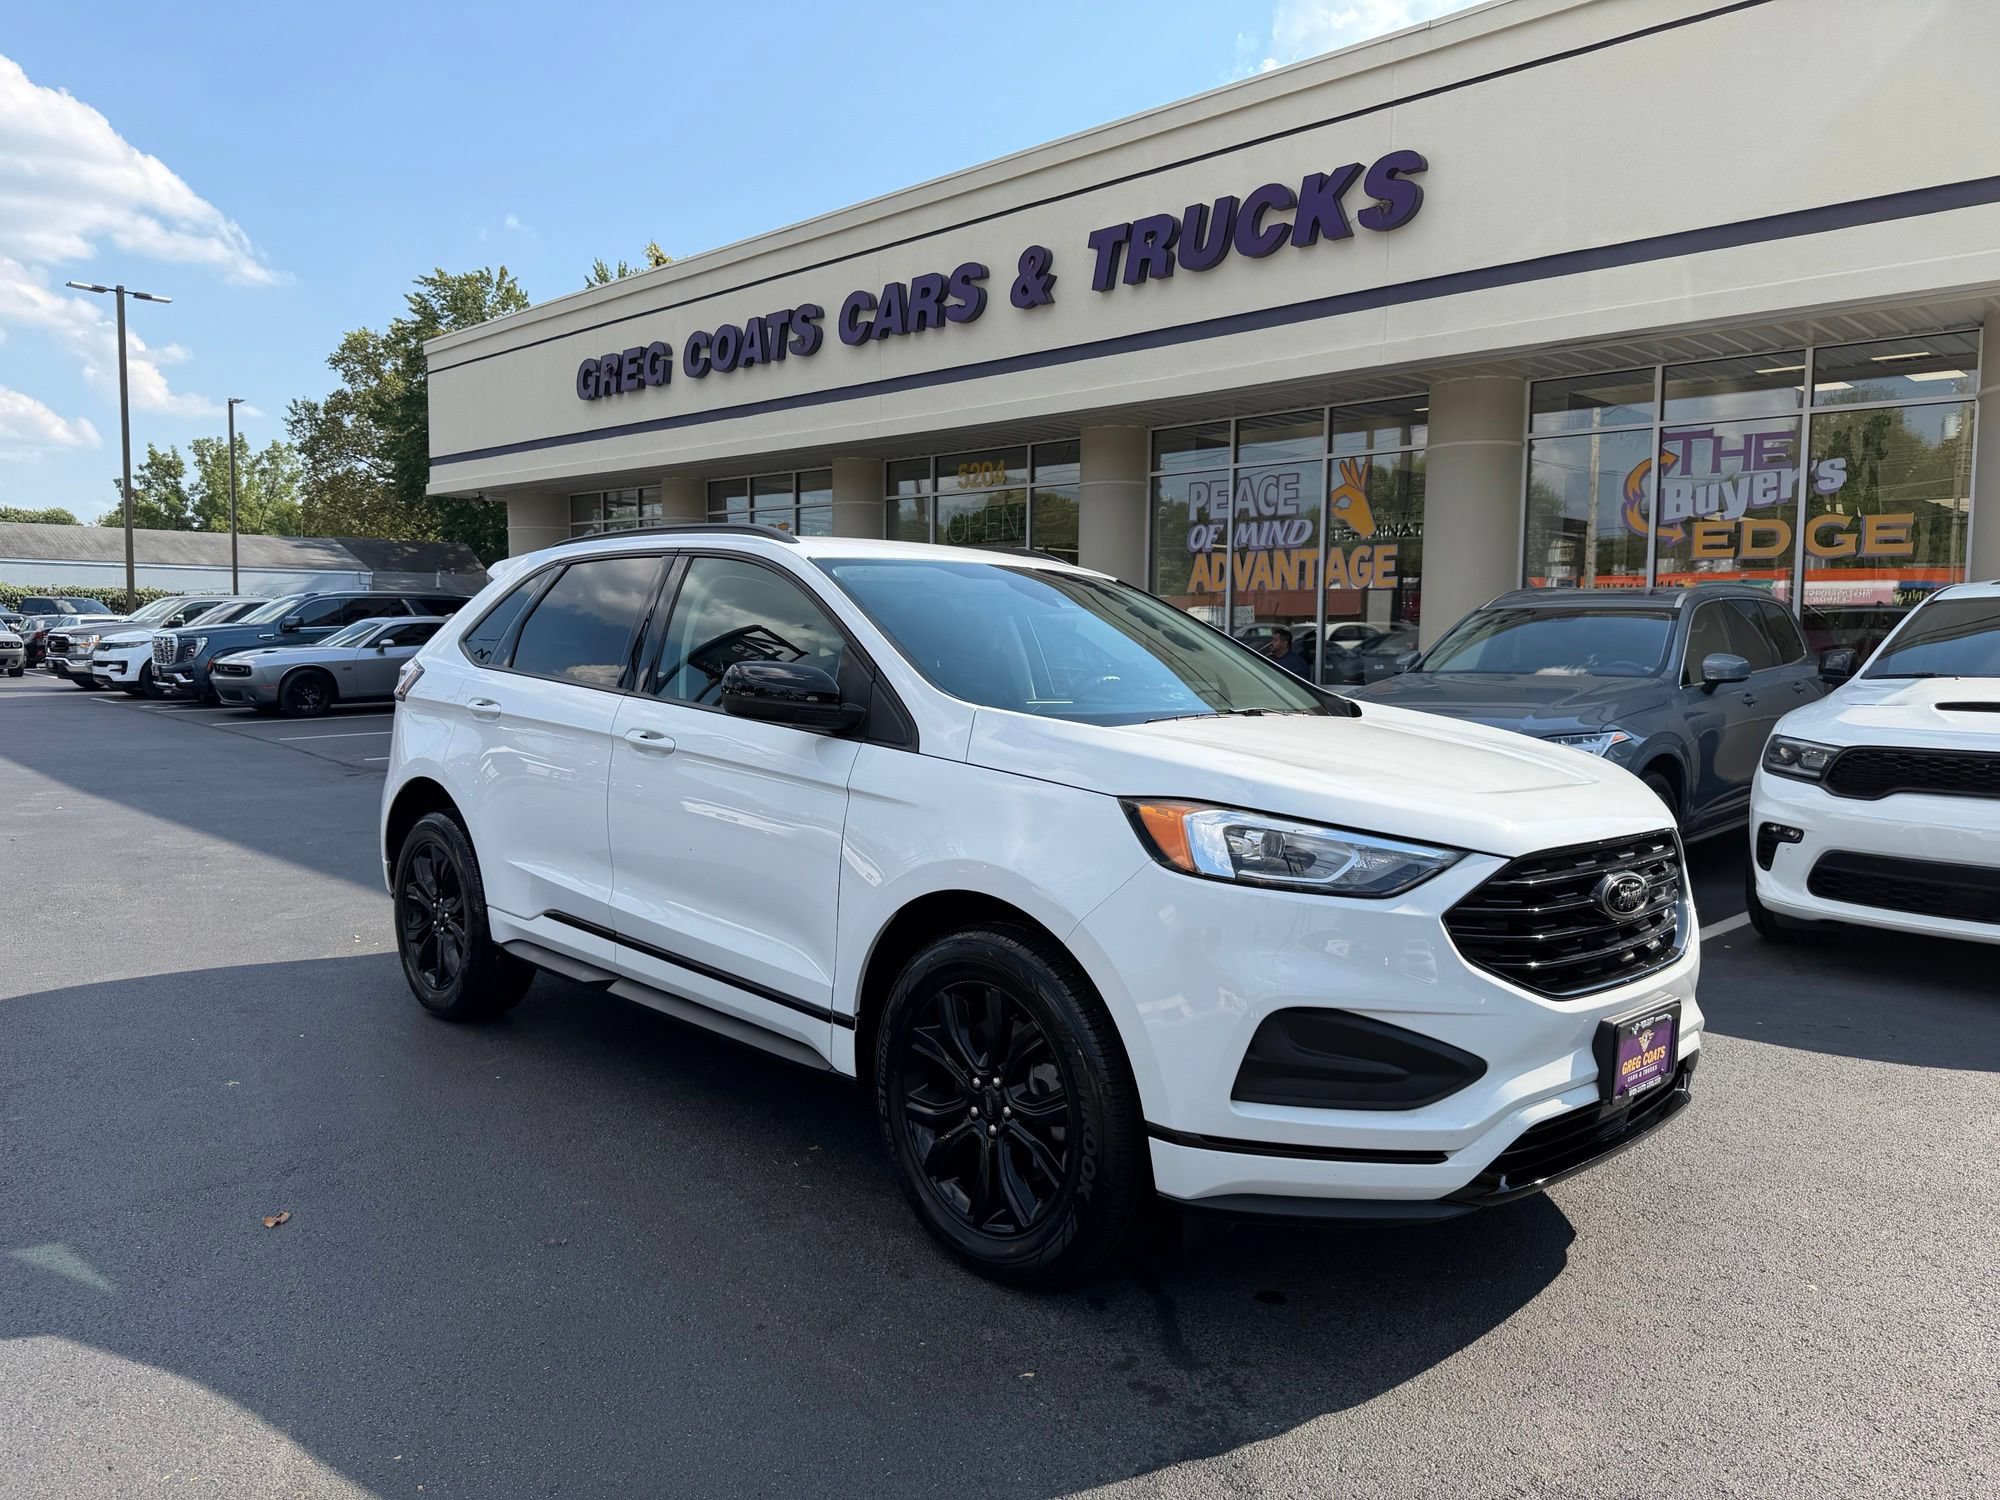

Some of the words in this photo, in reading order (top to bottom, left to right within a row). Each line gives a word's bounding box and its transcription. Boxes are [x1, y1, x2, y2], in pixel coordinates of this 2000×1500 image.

[576, 341, 672, 401] GREG
[683, 303, 824, 379] COATS
[838, 262, 990, 346] CARS
[1009, 245, 1056, 310] &
[1088, 149, 1430, 293] TRUCKS
[958, 460, 1006, 488] 5204
[1662, 427, 1797, 477] THE
[1188, 473, 1300, 521] PEACE
[948, 506, 1018, 542] OPEN
[1187, 522, 1228, 552] OF
[1233, 517, 1313, 550] MIND
[1691, 512, 1915, 560] EDGE
[1187, 544, 1399, 592] ADVANTAGE
[1622, 1055, 1641, 1075] GREG
[1643, 1046, 1666, 1066] COATS
